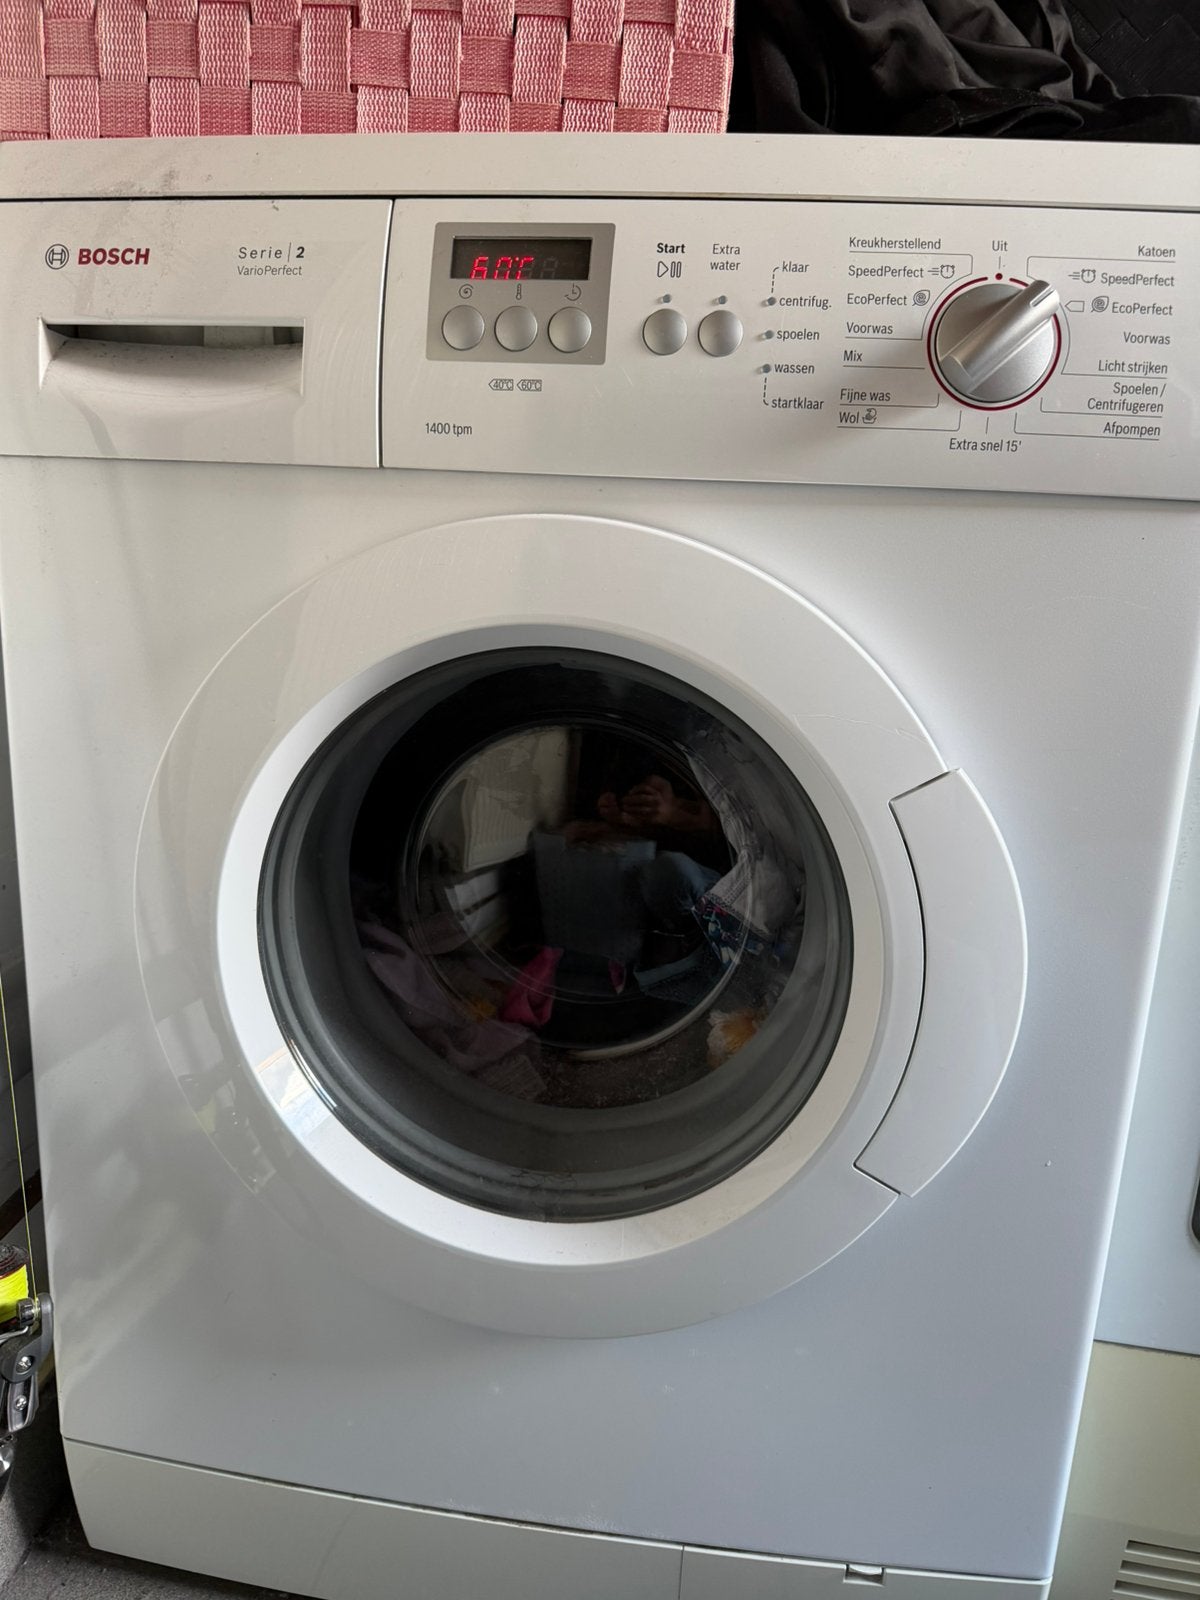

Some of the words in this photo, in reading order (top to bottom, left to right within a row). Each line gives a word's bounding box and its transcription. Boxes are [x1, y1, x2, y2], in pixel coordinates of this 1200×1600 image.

[656, 242, 686, 254] Start
[712, 243, 741, 255] Extra
[849, 237, 941, 250] Kreukherstellend
[991, 240, 1008, 252] Uit
[77, 248, 150, 265] BOSCH
[238, 246, 283, 259] Serie
[295, 246, 305, 259] 2
[1137, 245, 1176, 257] Katoen
[237, 265, 302, 276] VarioPerfect
[710, 261, 741, 271] water
[782, 261, 810, 273] klaar
[848, 265, 924, 278] SpeedPerfect
[1100, 272, 1175, 287] SpeedPerfect
[779, 296, 832, 311] centrifug.
[847, 293, 907, 306] EcoPerfect
[1111, 301, 1173, 316] EcoPerfect
[776, 329, 820, 341] spoelen
[846, 322, 893, 335] Voorwas
[1123, 331, 1171, 345] Voorwas
[843, 350, 863, 362] Mix
[774, 362, 815, 374] wassen
[1098, 360, 1126, 373] Licht
[1127, 361, 1168, 376] strijken
[493, 380, 513, 390] 40°C
[521, 380, 542, 391] 60°C
[1113, 382, 1157, 396] Spoelen
[1159, 383, 1166, 398] /
[840, 388, 867, 402] Fijne
[869, 390, 891, 401] was
[771, 398, 824, 410] startklaar
[1087, 398, 1164, 414] Centrifugeren
[839, 411, 860, 424] Wol
[425, 423, 450, 434] 1400
[452, 423, 473, 437] tpm
[1103, 422, 1161, 437] Afpompen
[949, 438, 978, 451] Extra
[980, 439, 1003, 452] snel
[1005, 440, 1022, 452] 15'
